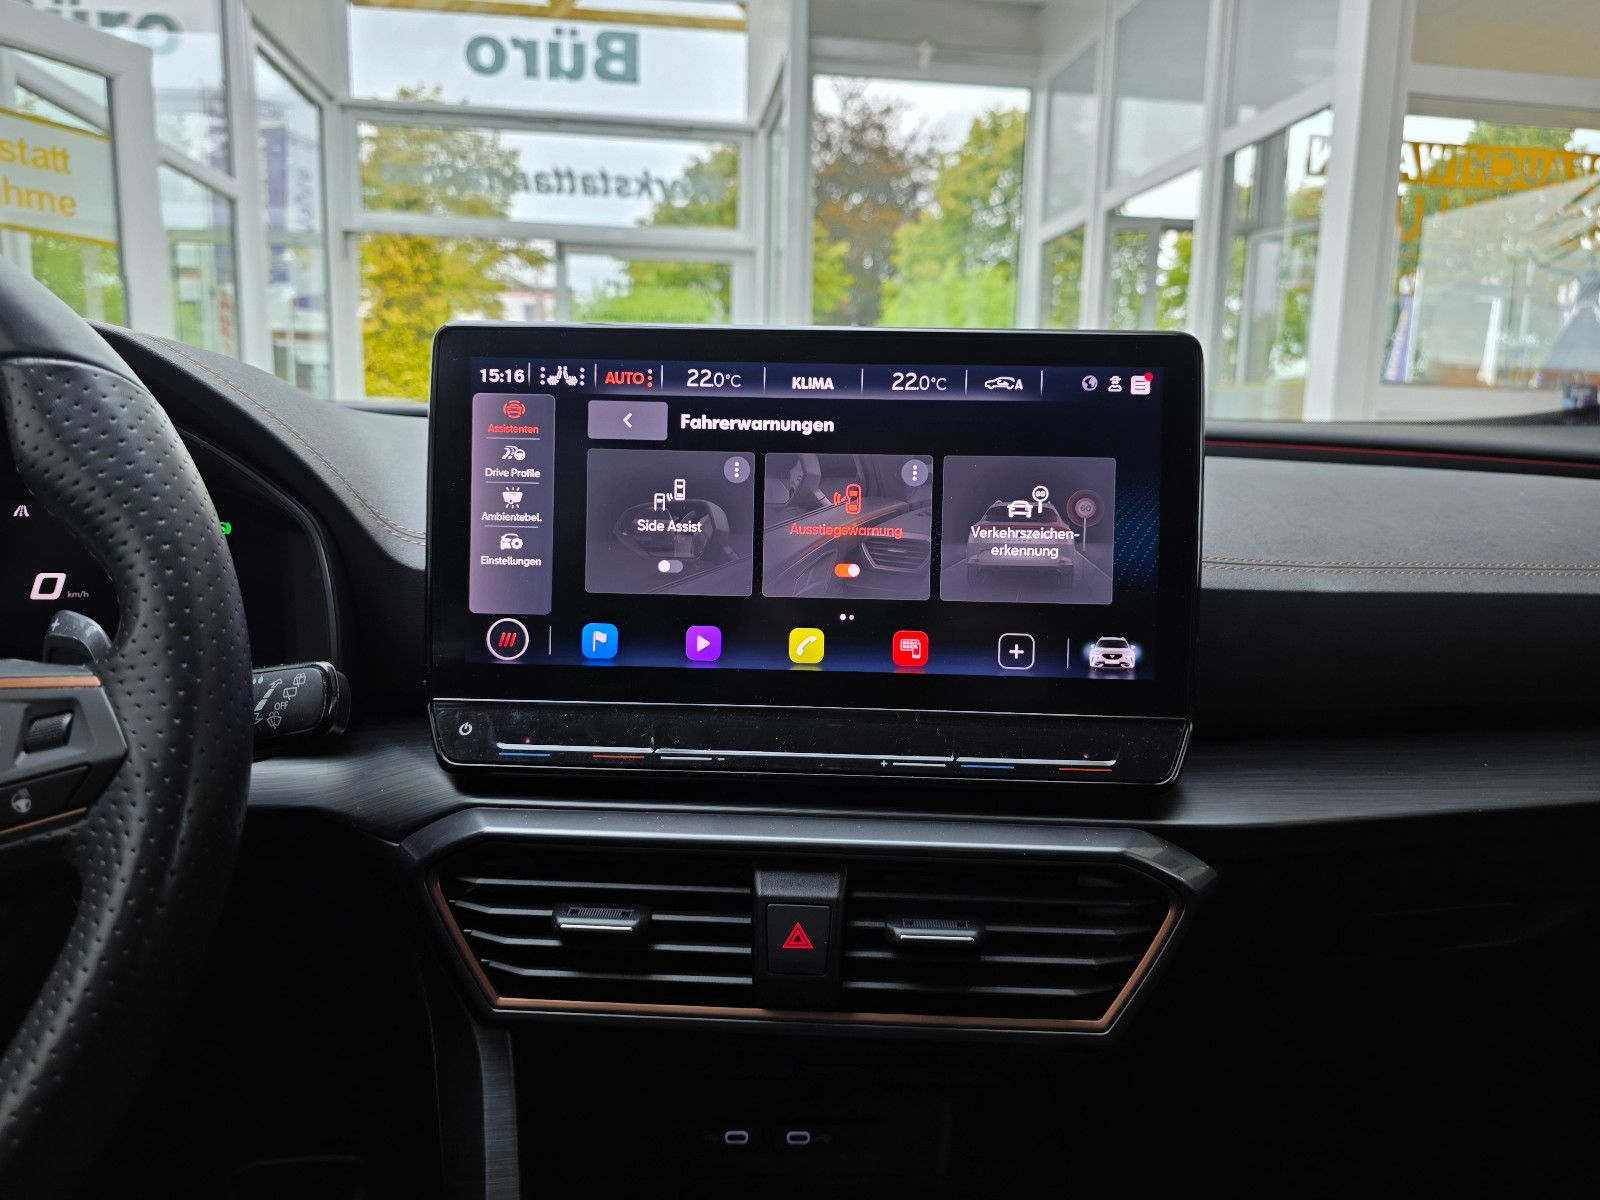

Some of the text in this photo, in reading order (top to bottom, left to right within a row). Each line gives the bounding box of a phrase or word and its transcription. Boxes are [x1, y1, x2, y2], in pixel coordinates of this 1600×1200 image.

[480, 368, 525, 383] 15:16
[604, 371, 645, 385] AUTO
[791, 376, 835, 390] KLIMA
[487, 423, 539, 434] Assistenten
[680, 413, 835, 436] Fahrerwarnungen
[485, 467, 541, 479] Drive Profile
[481, 511, 543, 523] Ambientebel.
[637, 519, 702, 533] Side Assist
[790, 523, 903, 539] Ausstiegswarnung
[971, 525, 1080, 540] Verkehrszeichen-
[991, 544, 1059, 560] erkennung
[480, 555, 542, 568] Einstellungen
[30, 572, 89, 600] 0 km/h
[274, 701, 289, 711] OFF
